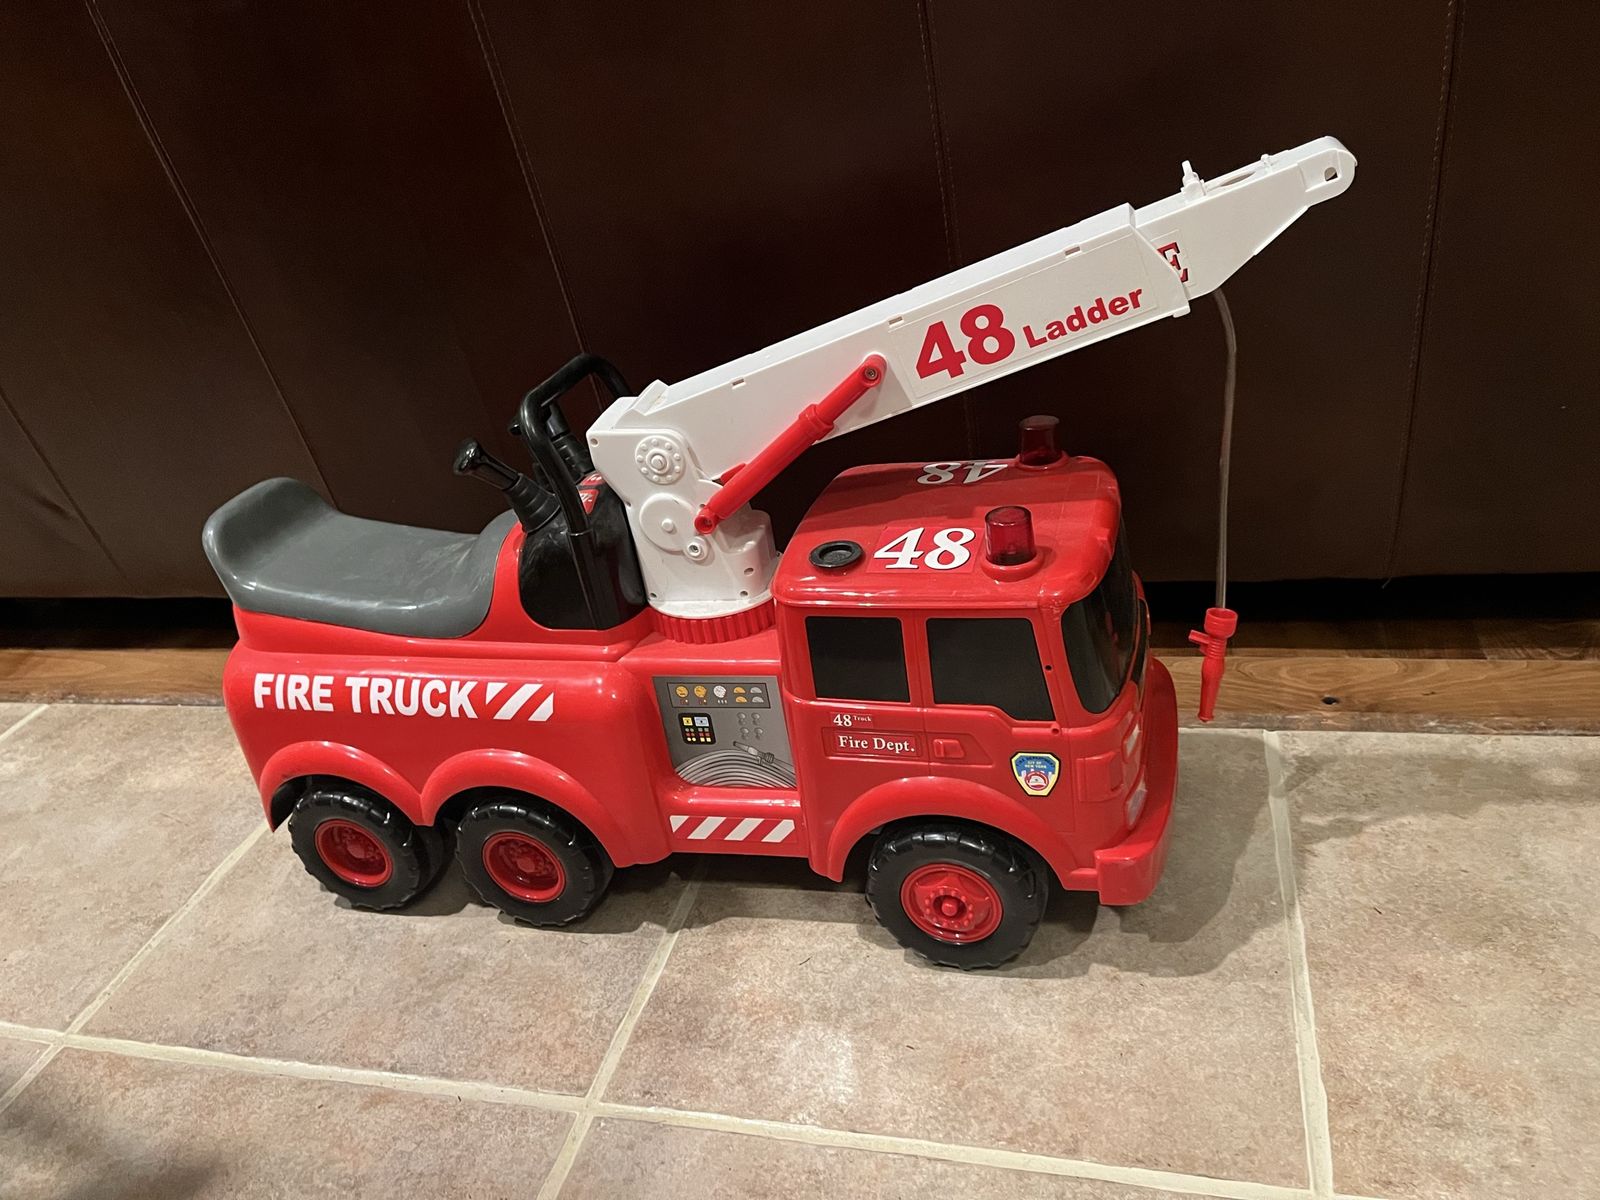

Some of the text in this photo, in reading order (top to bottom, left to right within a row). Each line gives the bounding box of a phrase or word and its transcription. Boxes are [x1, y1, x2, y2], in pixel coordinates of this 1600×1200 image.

[915, 288, 1143, 379] 48 Ladder
[917, 460, 1009, 484] 48
[873, 527, 976, 570] 48
[253, 673, 479, 719] FIRE TRUCK
[833, 713, 853, 727] 48
[838, 735, 916, 754] Fire Dept.
